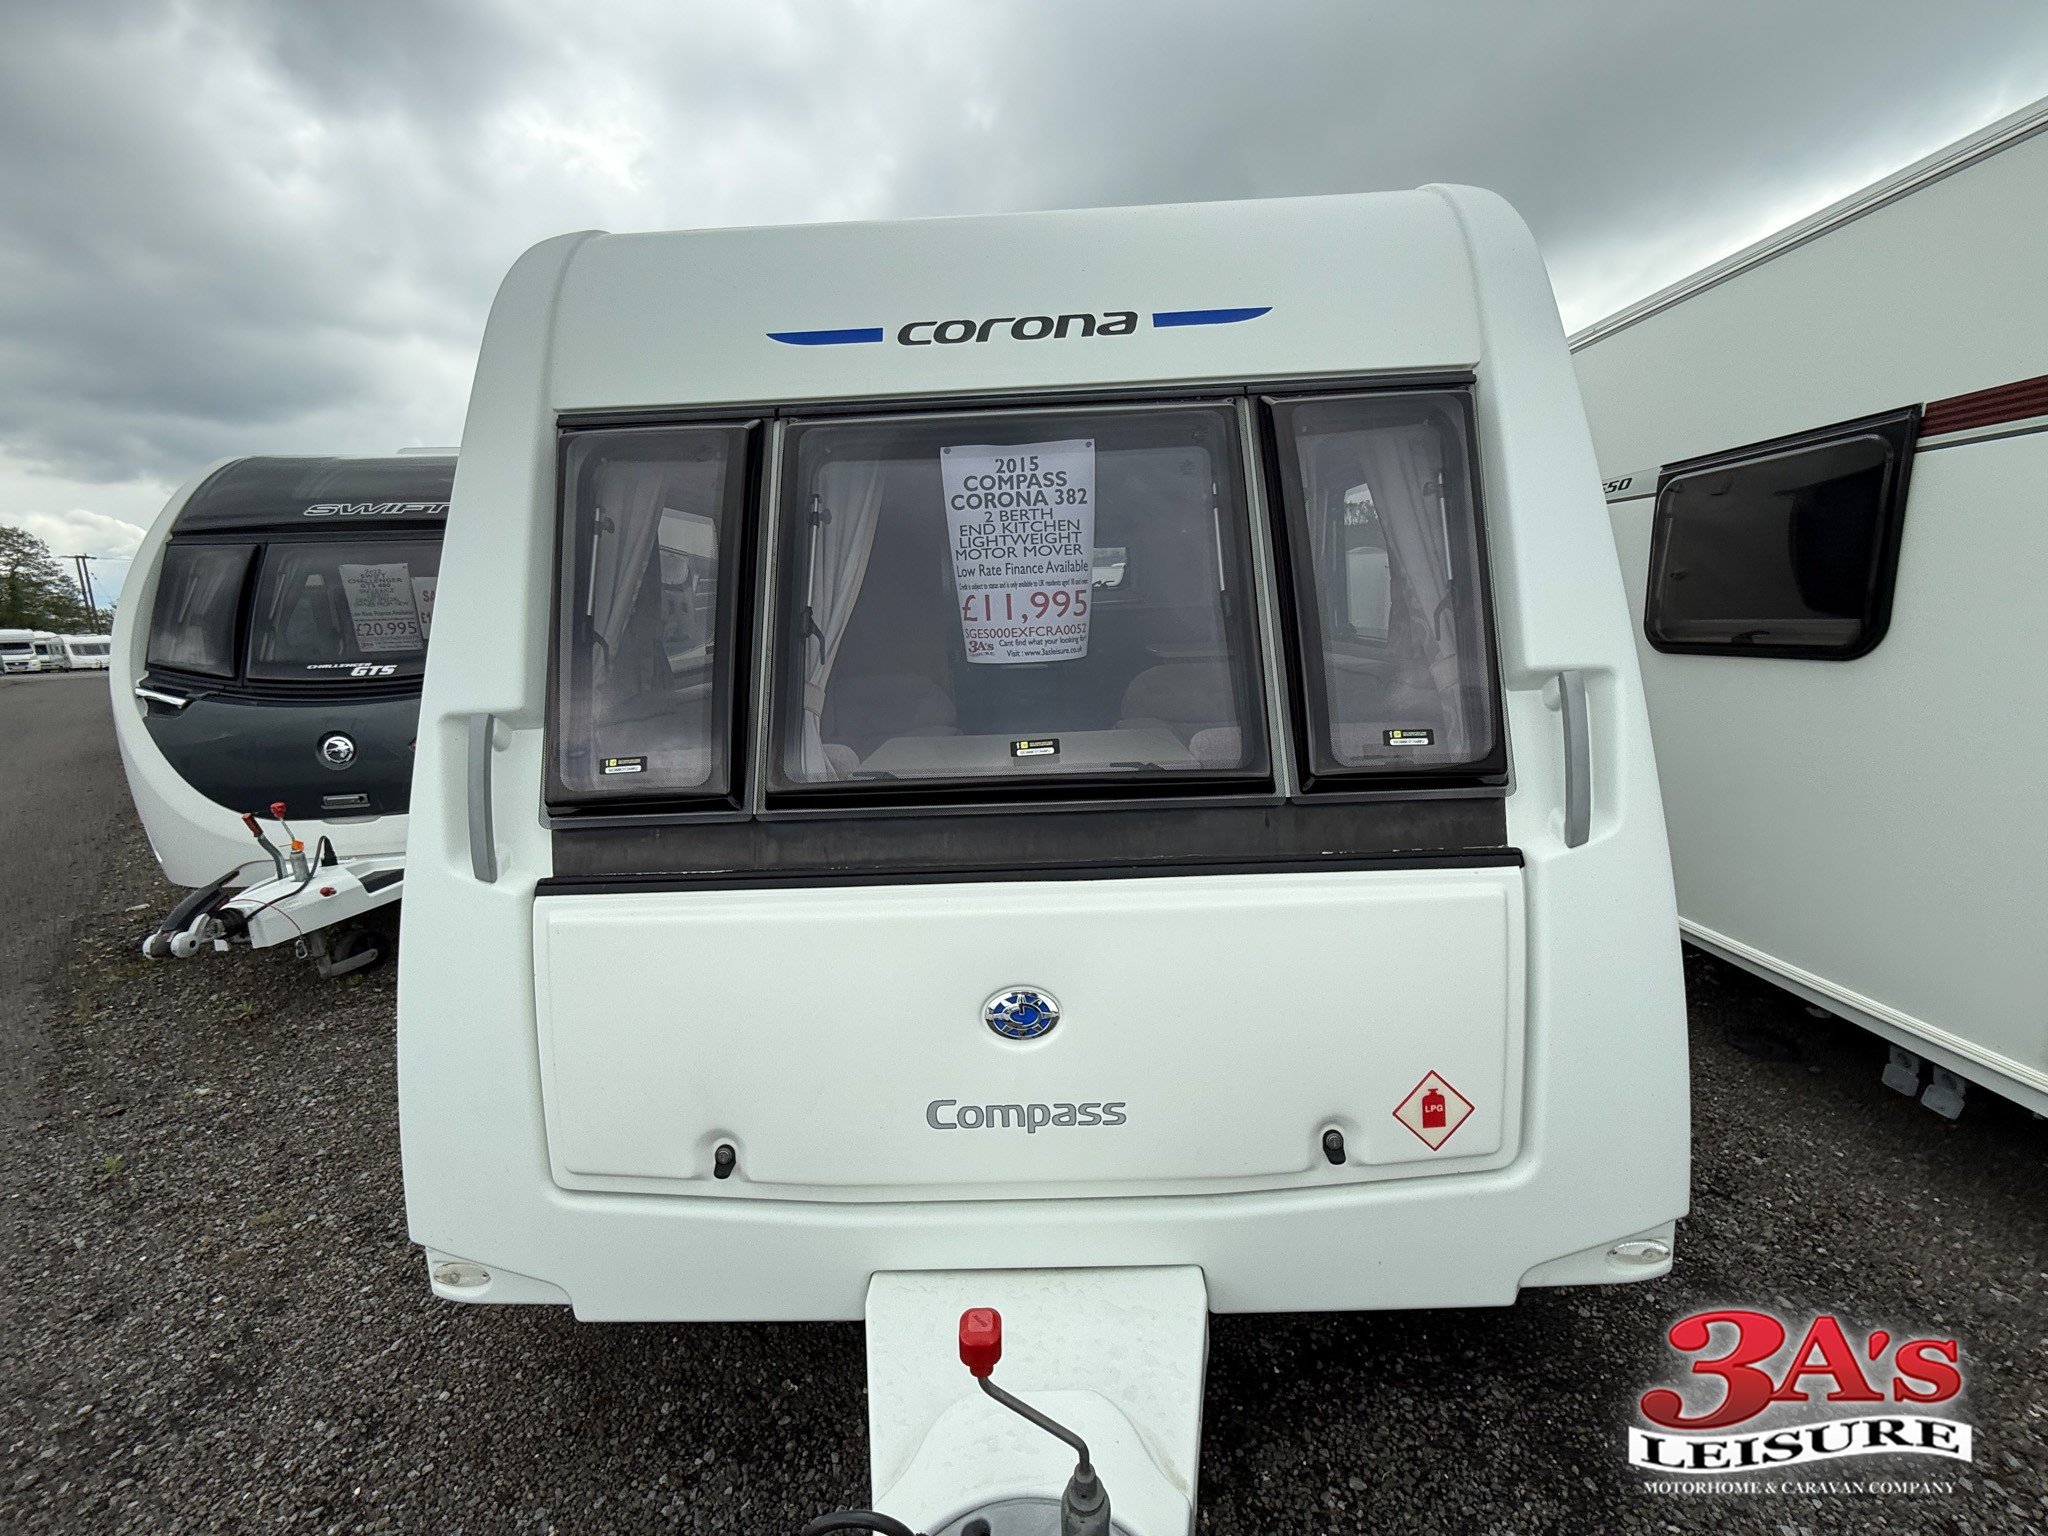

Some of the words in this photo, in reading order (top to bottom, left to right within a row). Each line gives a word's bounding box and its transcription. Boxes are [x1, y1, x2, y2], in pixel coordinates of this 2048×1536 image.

[897, 310, 1138, 346] corona
[995, 456, 1039, 474] 2015
[963, 471, 1068, 492] COMPASS
[951, 490, 1049, 511] CORONA
[1054, 488, 1088, 505] 382
[303, 502, 450, 517] SWIFT
[984, 511, 994, 523] 2
[1000, 508, 1053, 522] BERTH
[960, 523, 996, 537] END
[1002, 519, 1080, 534] KITCHEN
[959, 532, 1082, 549] LIGHTWEIGHT
[955, 547, 1018, 561] MOTOR
[1024, 544, 1083, 558] MOVER
[956, 565, 976, 578] Low
[979, 564, 1002, 577] Rate
[1005, 562, 1044, 576] Finance
[1046, 559, 1089, 574] Available
[962, 589, 1088, 623] £11,995
[968, 640, 995, 653] 3A's
[998, 639, 1014, 647] Cant
[1015, 638, 1027, 646] find
[1028, 637, 1044, 646] what
[1044, 638, 1059, 647] your
[1060, 635, 1079, 645] looking
[1007, 649, 1021, 658] Visit
[306, 662, 373, 670] CHALLENGER
[351, 664, 398, 677] GTS
[926, 1099, 1127, 1134] Compass
[1424, 1104, 1444, 1113] LPG
